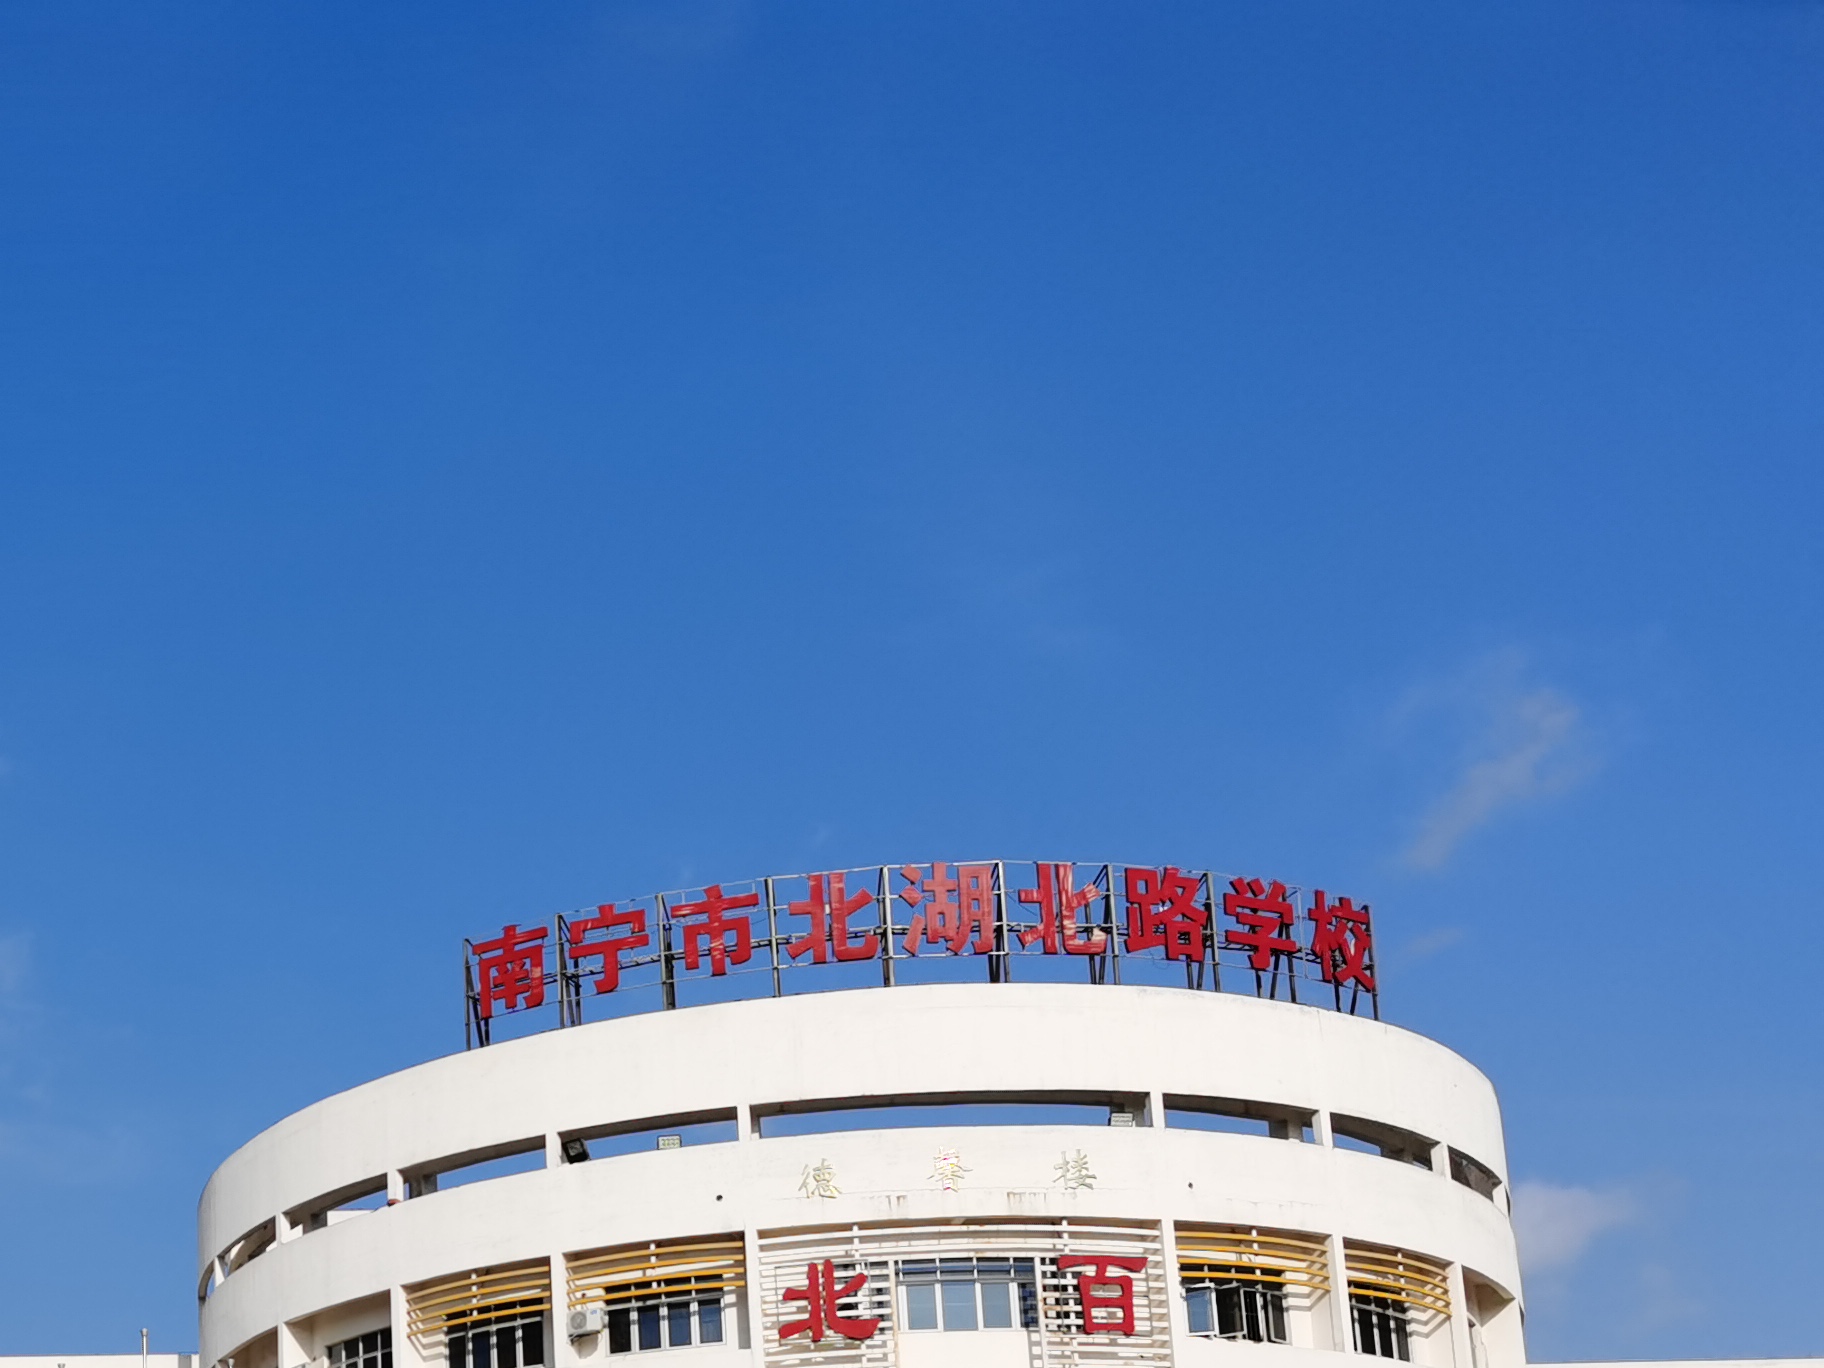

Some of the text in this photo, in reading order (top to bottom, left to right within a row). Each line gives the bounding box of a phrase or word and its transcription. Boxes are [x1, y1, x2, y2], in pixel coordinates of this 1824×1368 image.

[473, 861, 1375, 1018] 南宁市北湖北路学校
[798, 1146, 1097, 1199] 德馨楼
